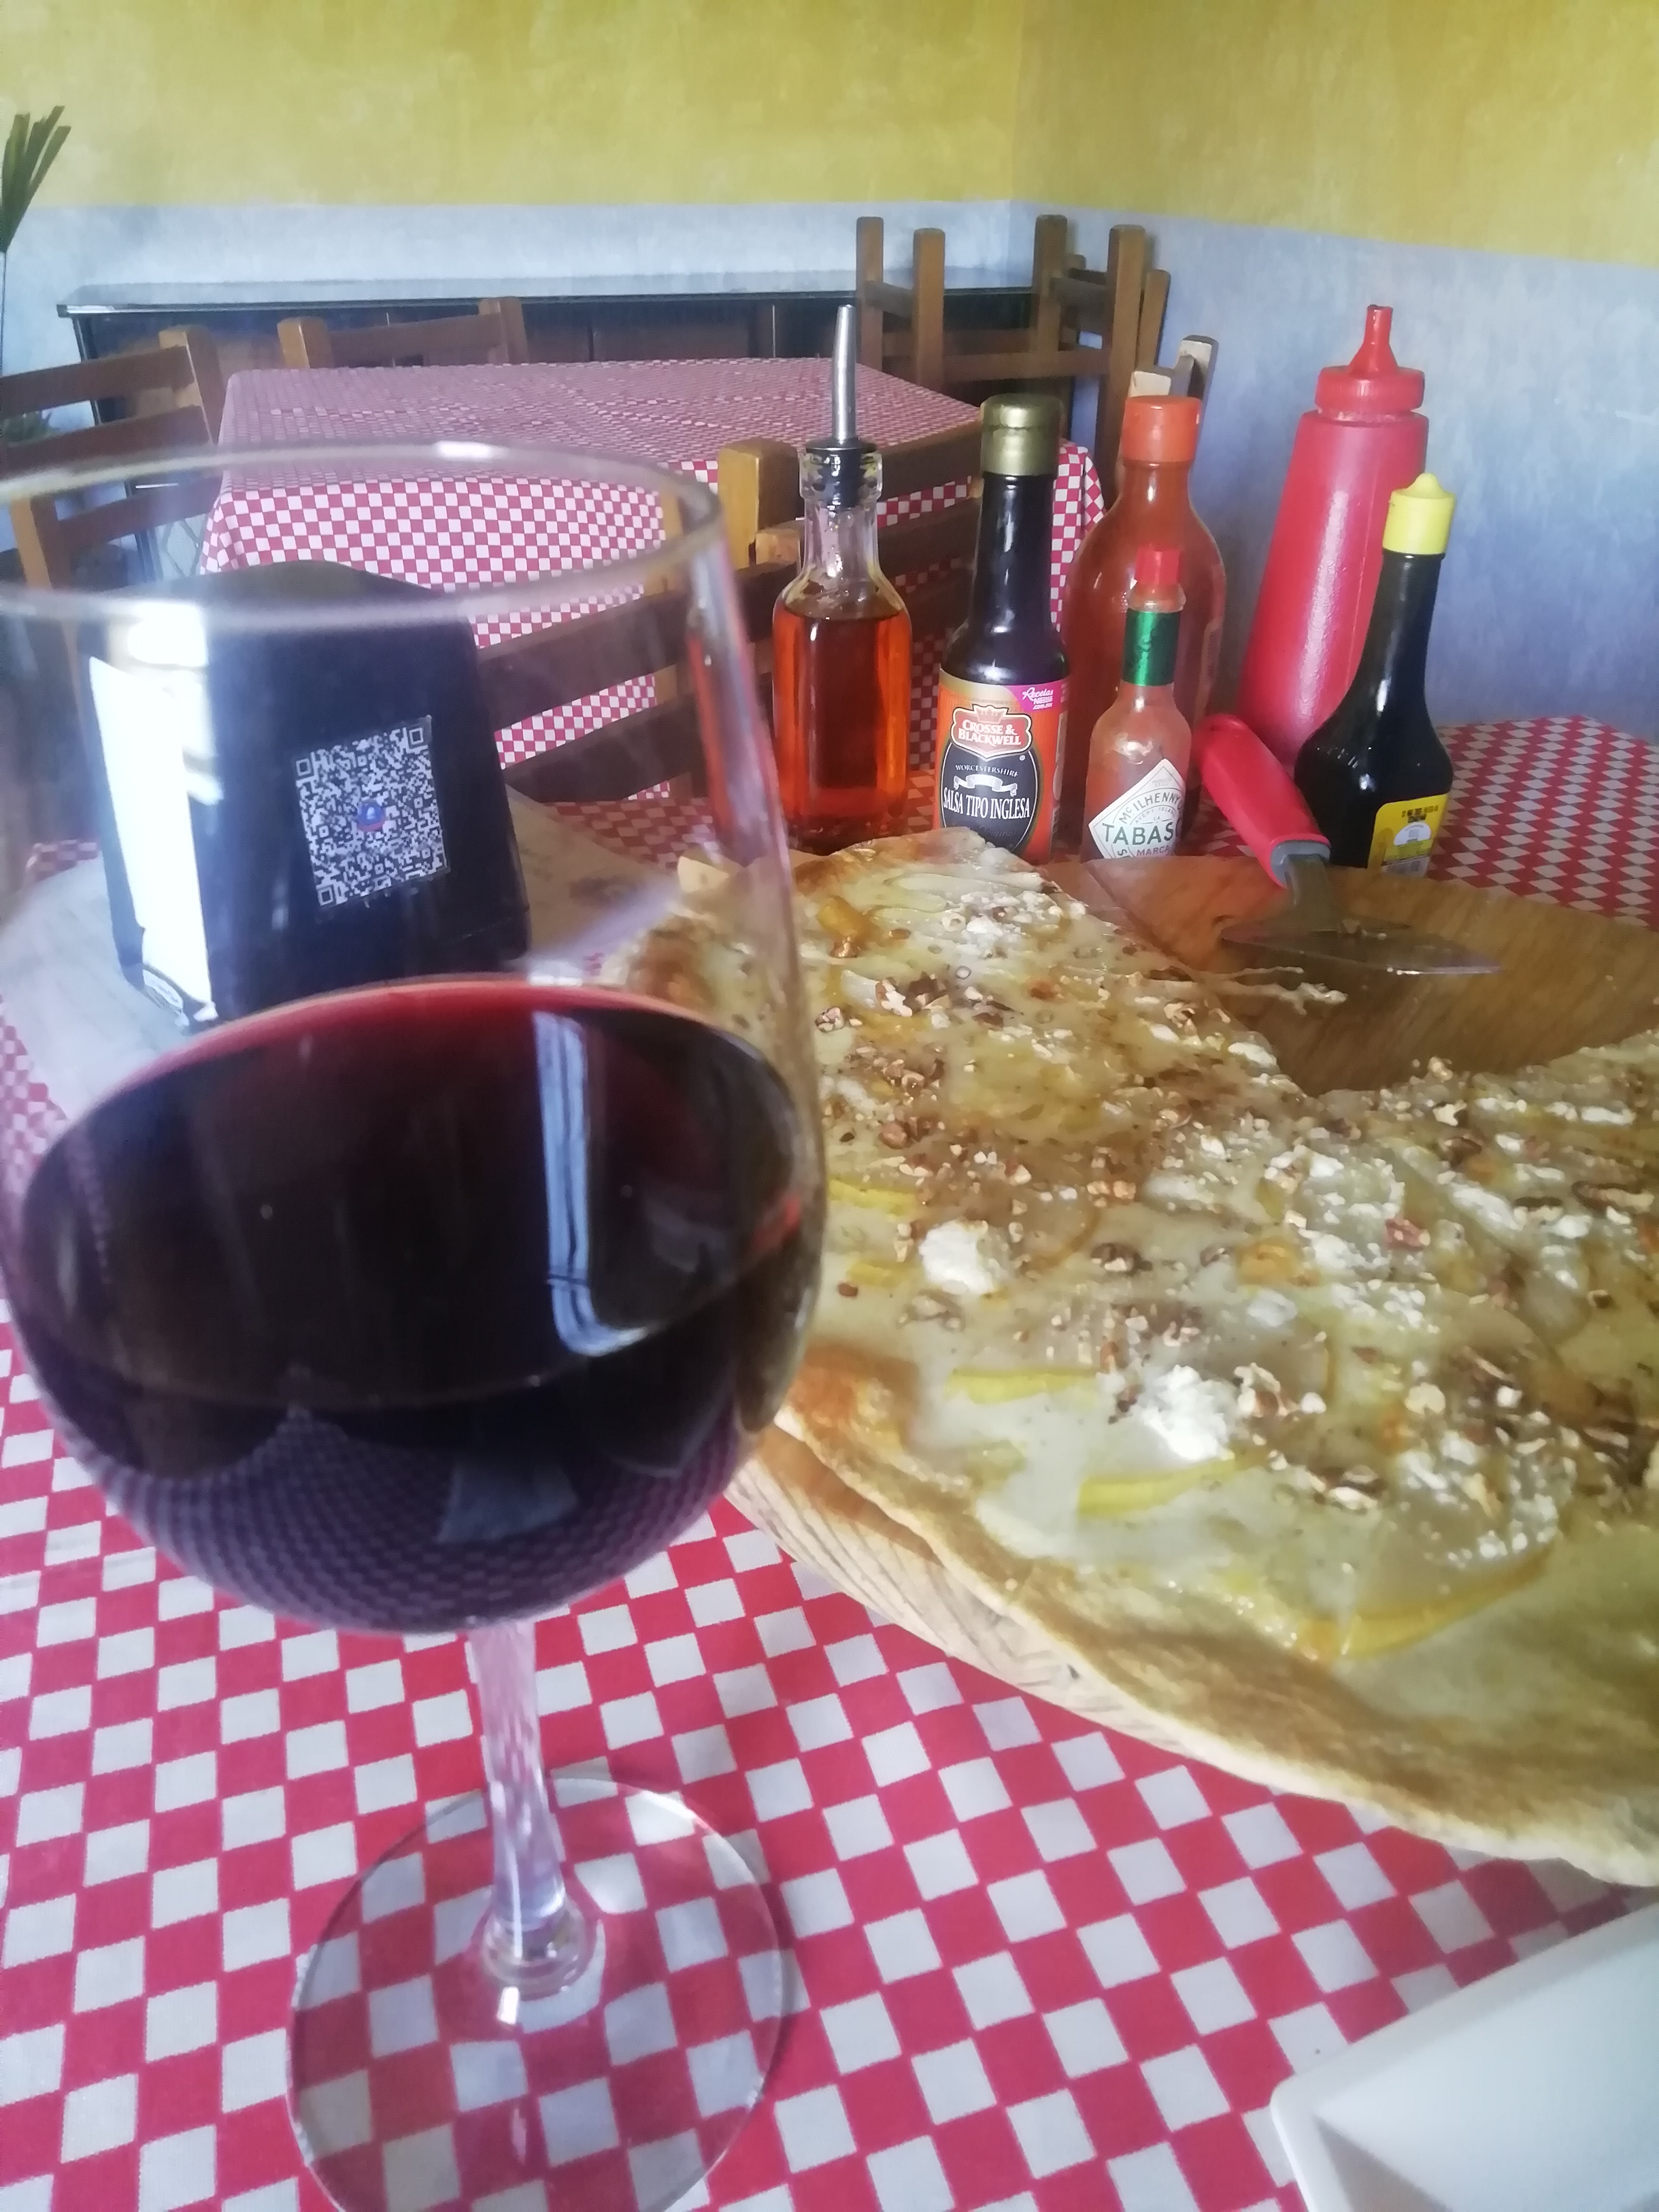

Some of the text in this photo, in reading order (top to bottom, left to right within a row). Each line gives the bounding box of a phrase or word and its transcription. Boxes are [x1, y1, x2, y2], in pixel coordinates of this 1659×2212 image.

[962, 719, 1018, 735] CROSSE &
[958, 728, 1021, 747] BLACKWELL
[955, 765, 1018, 777] WORCESTERSHIRE
[943, 787, 1030, 820] SALSA TIPO INGLESA
[1102, 819, 1182, 845] TABAS
[1136, 844, 1170, 857] MARCA
